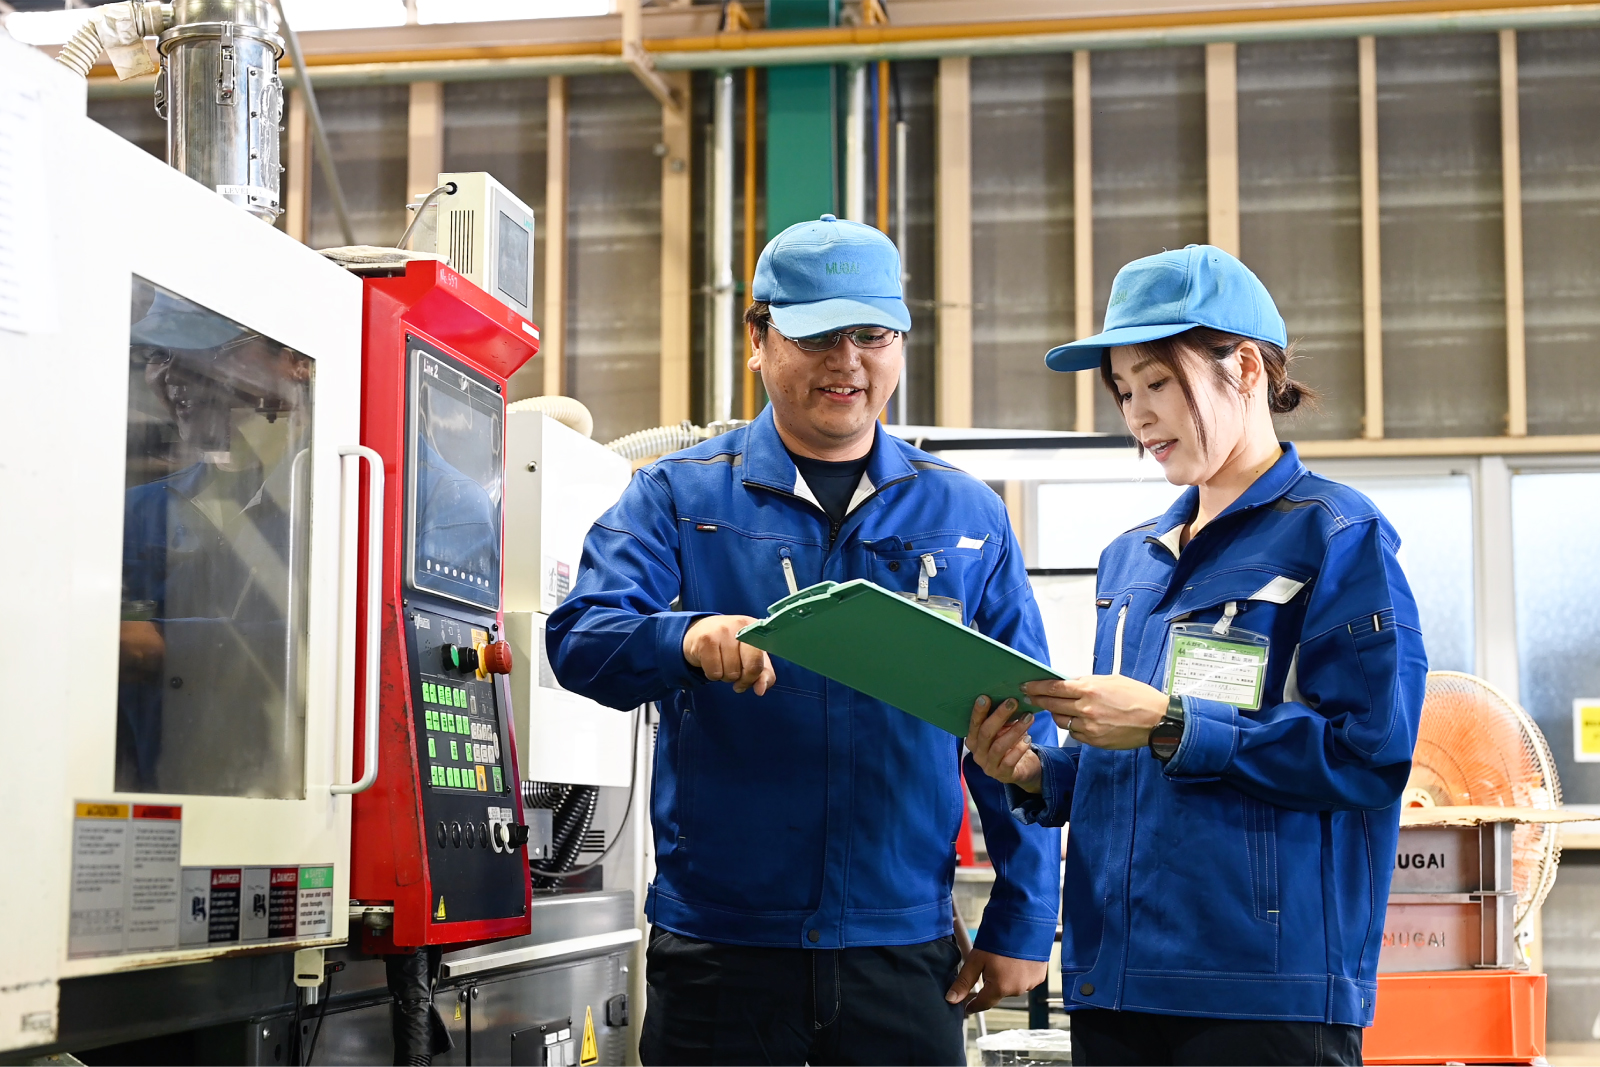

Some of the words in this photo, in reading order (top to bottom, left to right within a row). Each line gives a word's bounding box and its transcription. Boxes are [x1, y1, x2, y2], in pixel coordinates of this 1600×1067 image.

[826, 261, 860, 276] MUGAI
[218, 873, 240, 884] DANGER
[276, 873, 297, 882] DANGER
[309, 869, 327, 878] SAFETY
[311, 878, 325, 887] FIRST
[1383, 931, 1446, 948] MUGAI
